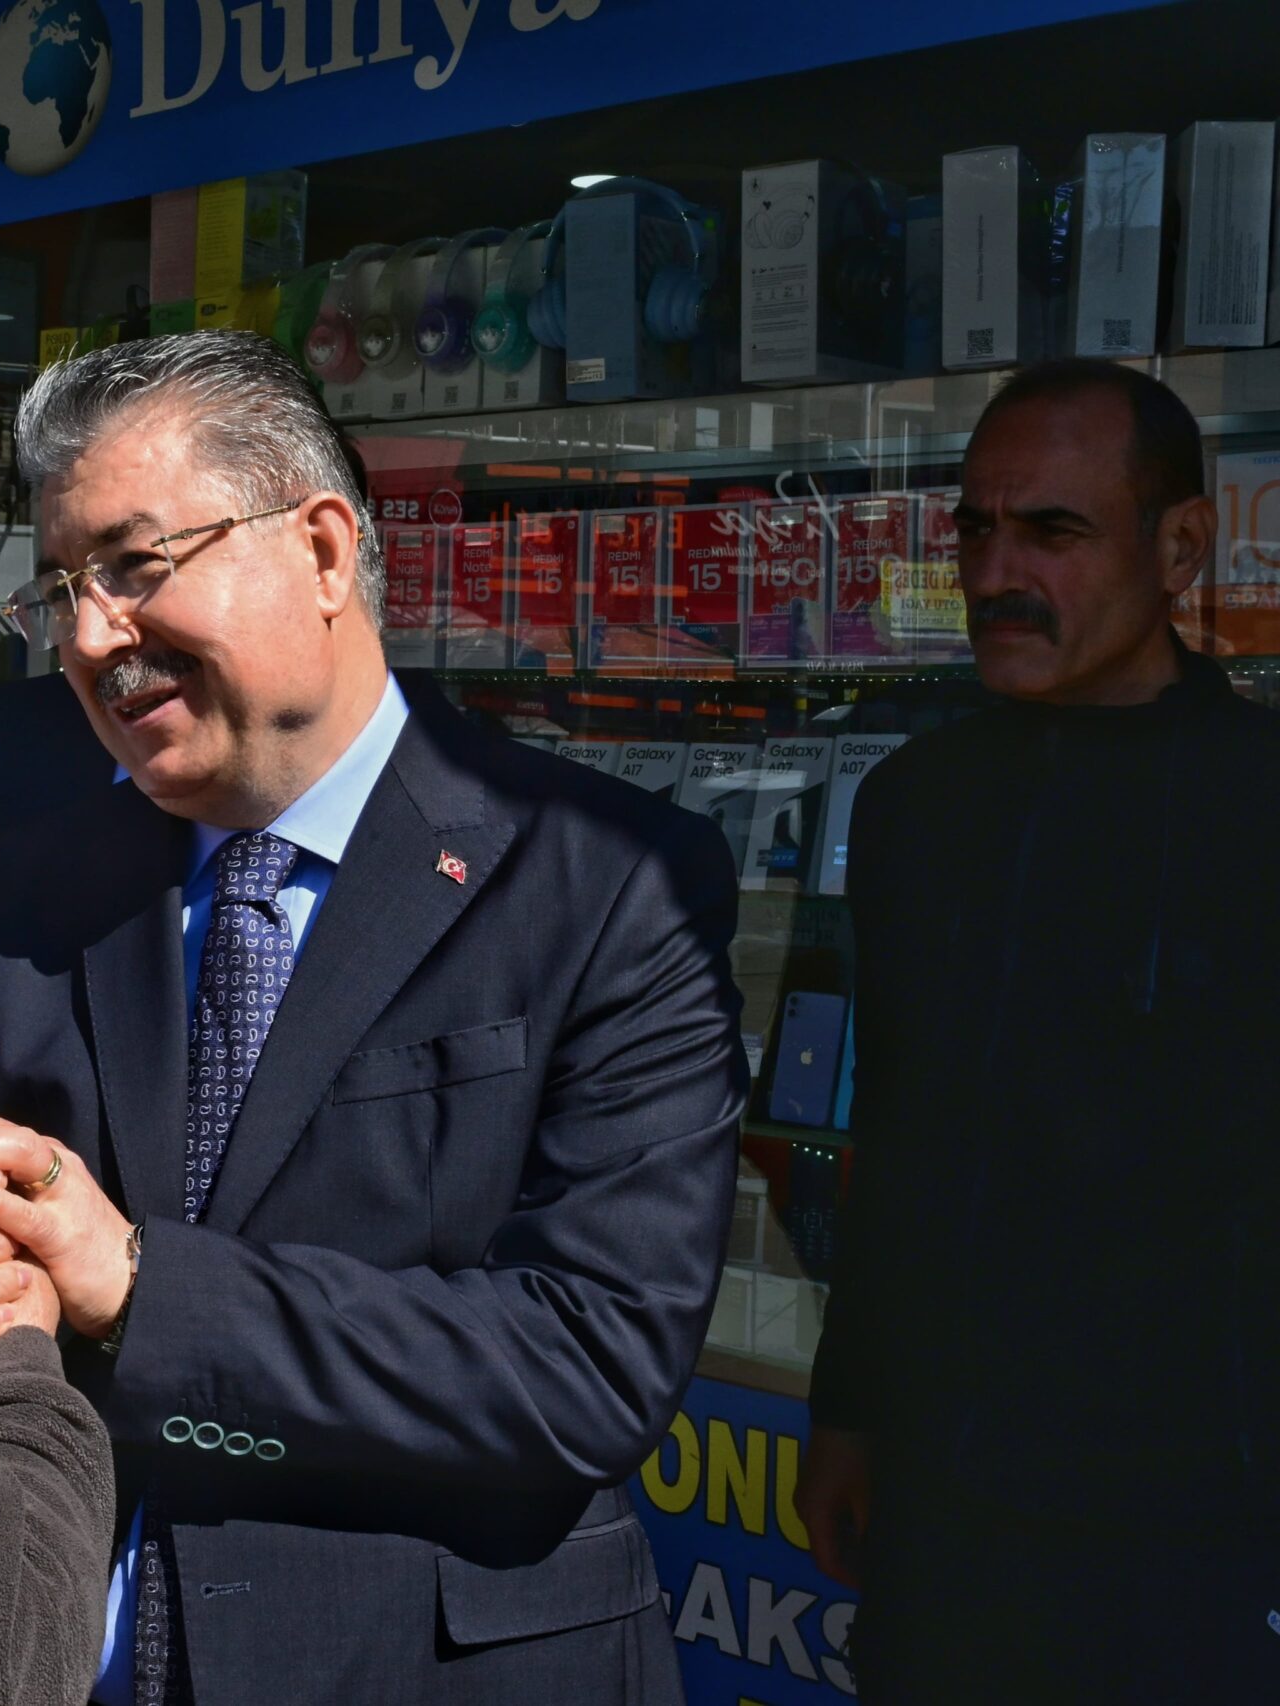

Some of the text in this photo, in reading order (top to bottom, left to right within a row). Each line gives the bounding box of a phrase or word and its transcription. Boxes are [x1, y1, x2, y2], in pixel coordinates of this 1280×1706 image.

[463, 548, 494, 559] REDMI
[607, 551, 641, 561] REDMI
[395, 562, 423, 575] Note
[463, 562, 492, 573] Note
[532, 567, 563, 594] 15
[607, 565, 640, 592] 15
[687, 562, 722, 591] 15
[463, 576, 491, 602] 15
[560, 747, 607, 762] Galaxy
[626, 748, 676, 763] Galaxy
[693, 748, 746, 764] Galaxy
[770, 744, 824, 760] Galaxy
[840, 742, 897, 757] Galaxy
[622, 764, 644, 776] A17
[690, 766, 711, 778] A17
[767, 762, 793, 776] A07
[838, 762, 865, 774] A07
